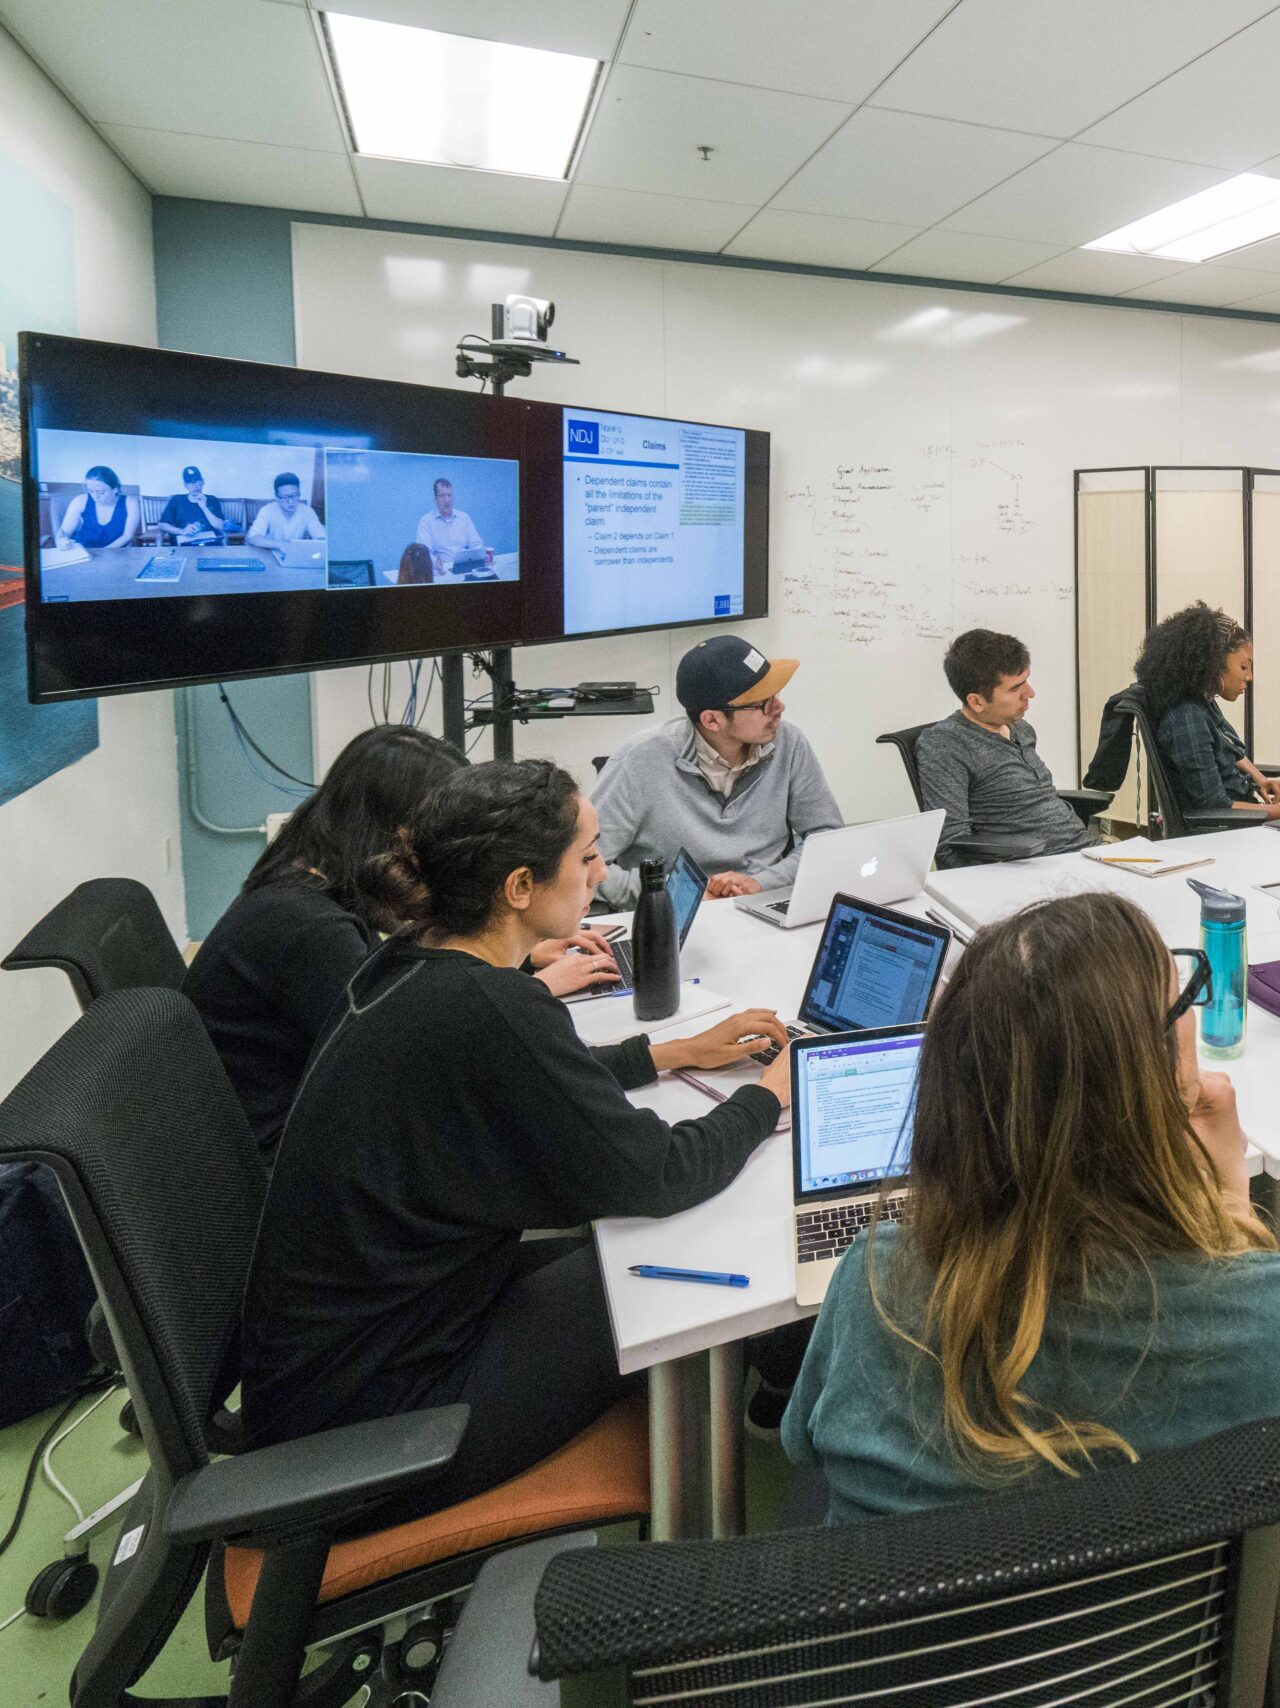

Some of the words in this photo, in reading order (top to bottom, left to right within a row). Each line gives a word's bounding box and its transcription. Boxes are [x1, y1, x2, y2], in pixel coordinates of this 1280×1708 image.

[569, 428, 594, 445] NDJ
[642, 440, 667, 451] Claims
[585, 475, 624, 487] Dependent
[626, 477, 648, 488] claims
[649, 480, 673, 489] contain
[585, 490, 594, 499] all
[595, 490, 607, 499] the
[609, 490, 643, 500] limitations
[644, 491, 652, 500] of
[652, 492, 663, 501] the
[615, 504, 657, 514] independent
[594, 532, 612, 541] Claim
[619, 532, 644, 542] depends
[653, 531, 670, 540] Claim
[594, 546, 628, 555] Dependent
[628, 546, 648, 554] claims
[622, 557, 636, 565] than
[636, 556, 674, 565] independents
